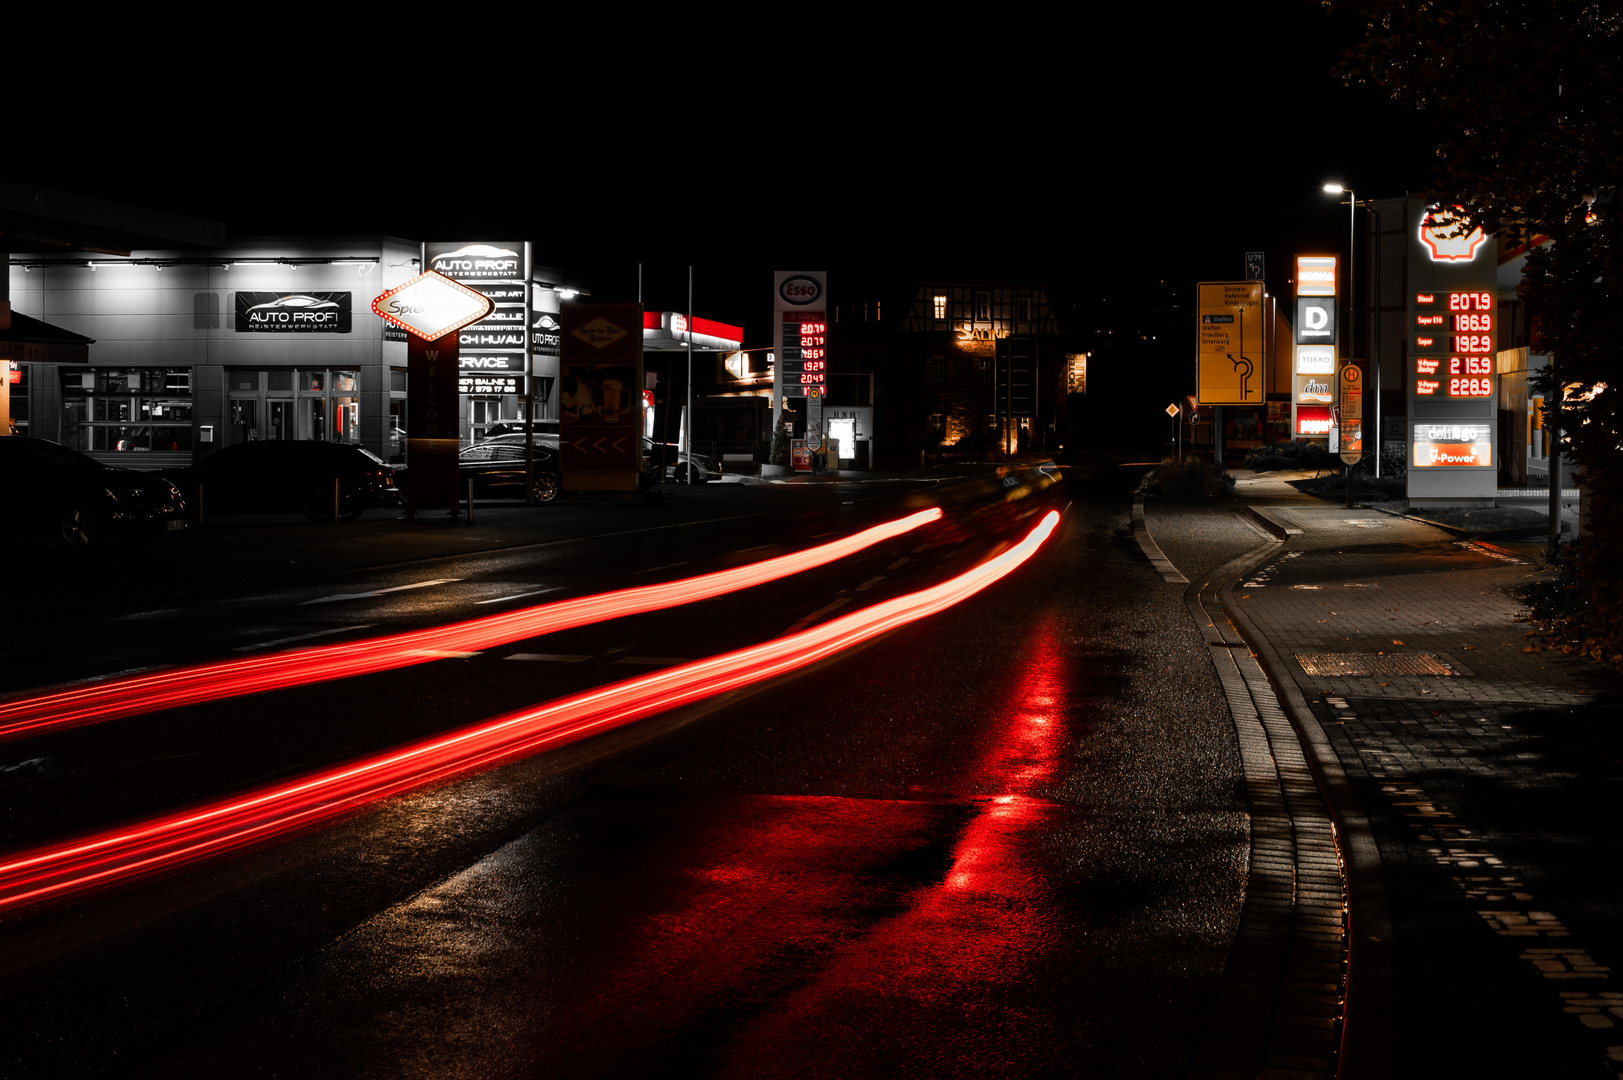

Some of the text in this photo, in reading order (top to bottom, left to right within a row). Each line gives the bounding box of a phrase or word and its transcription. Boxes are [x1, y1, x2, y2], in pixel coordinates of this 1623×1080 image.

[435, 260, 517, 270] AUTO PROFI
[786, 283, 815, 296] Esso
[1417, 293, 1491, 310] Diesel 207.9
[249, 312, 338, 323] AUTO PROFI
[1306, 307, 1328, 330] D
[1455, 314, 1491, 331] 186.9
[481, 334, 524, 344] HU/AU
[1455, 335, 1491, 352] 192.9
[1068, 352, 1076, 390] HOTEL
[1304, 378, 1329, 395] dm
[1450, 379, 1491, 395] 228.9
[425, 350, 440, 450] WELCOME
[1430, 453, 1475, 463] V-Power
